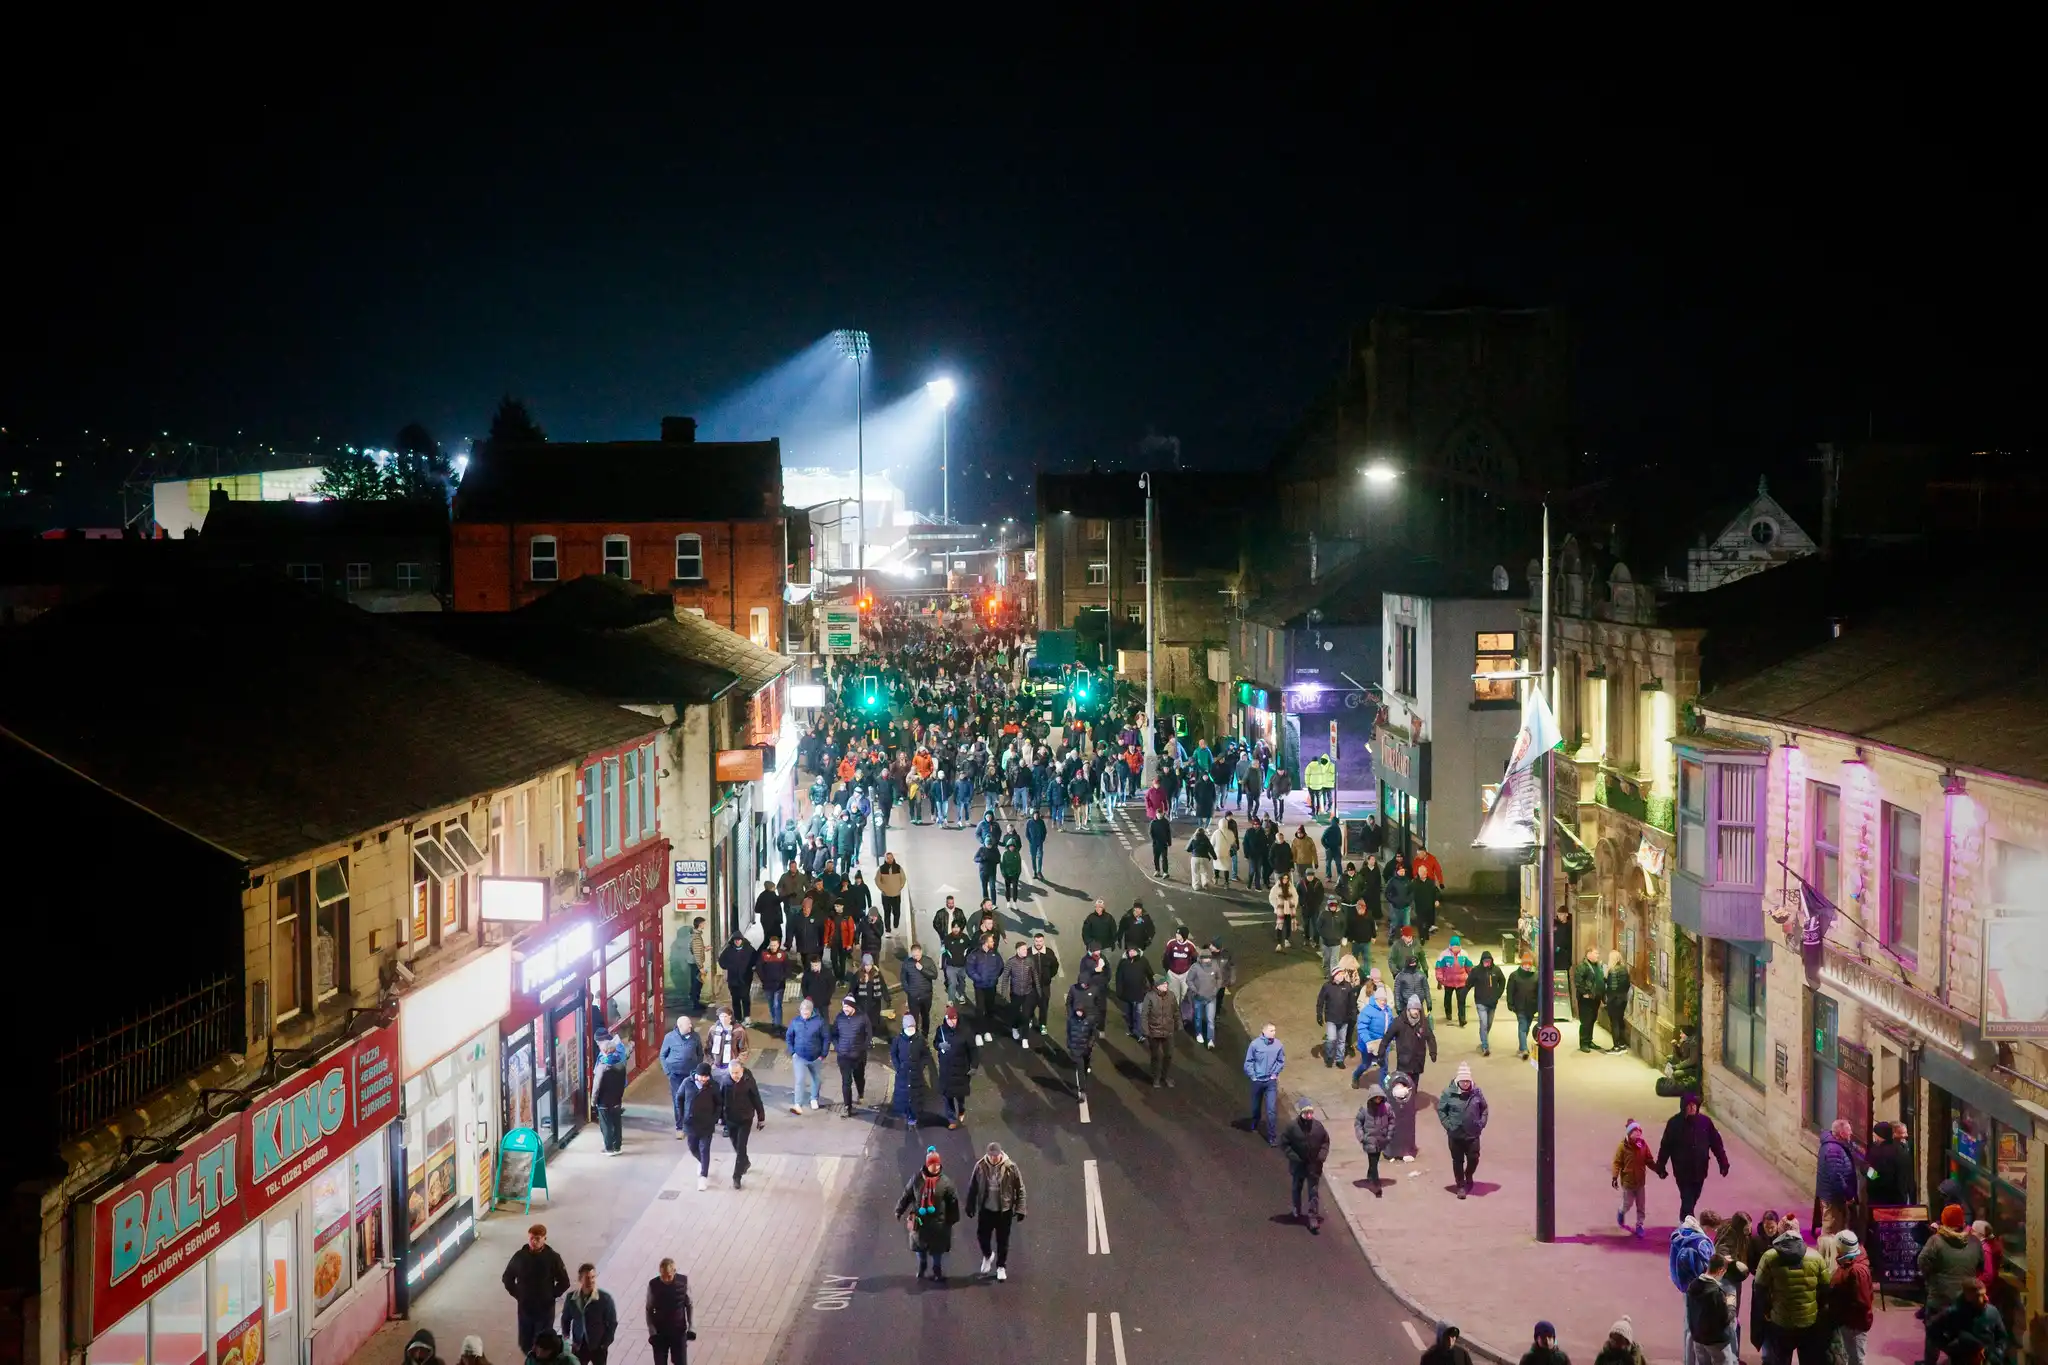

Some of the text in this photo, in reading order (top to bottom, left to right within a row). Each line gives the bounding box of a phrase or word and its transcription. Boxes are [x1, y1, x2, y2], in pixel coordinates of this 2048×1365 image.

[596, 864, 641, 927] KINGS
[1541, 1032, 1558, 1042] 20
[360, 1045, 380, 1068] PIZZA
[361, 1090, 391, 1121] CURRIES
[110, 1133, 237, 1287] BALTI
[252, 1067, 346, 1185] KING
[264, 1181, 282, 1198] TEL:
[141, 1221, 221, 1288] DELIVERY SERVICE
[812, 1274, 859, 1311] ONLY
